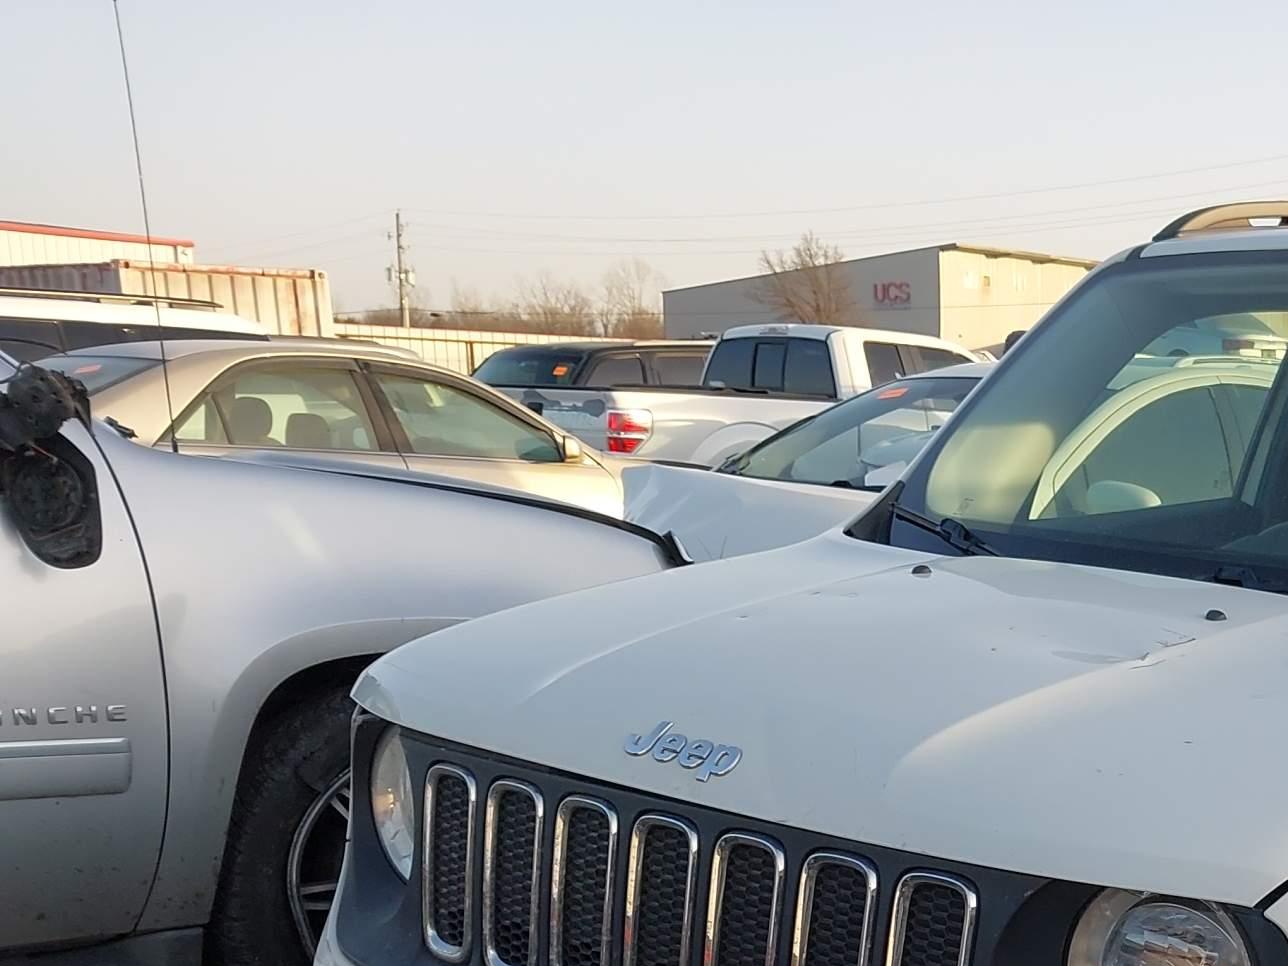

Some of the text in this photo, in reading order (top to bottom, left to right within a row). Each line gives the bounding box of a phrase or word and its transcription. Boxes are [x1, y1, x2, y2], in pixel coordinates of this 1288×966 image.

[873, 282, 911, 303] UCS
[0, 704, 127, 726] NCHE
[624, 720, 743, 783] Jeep
